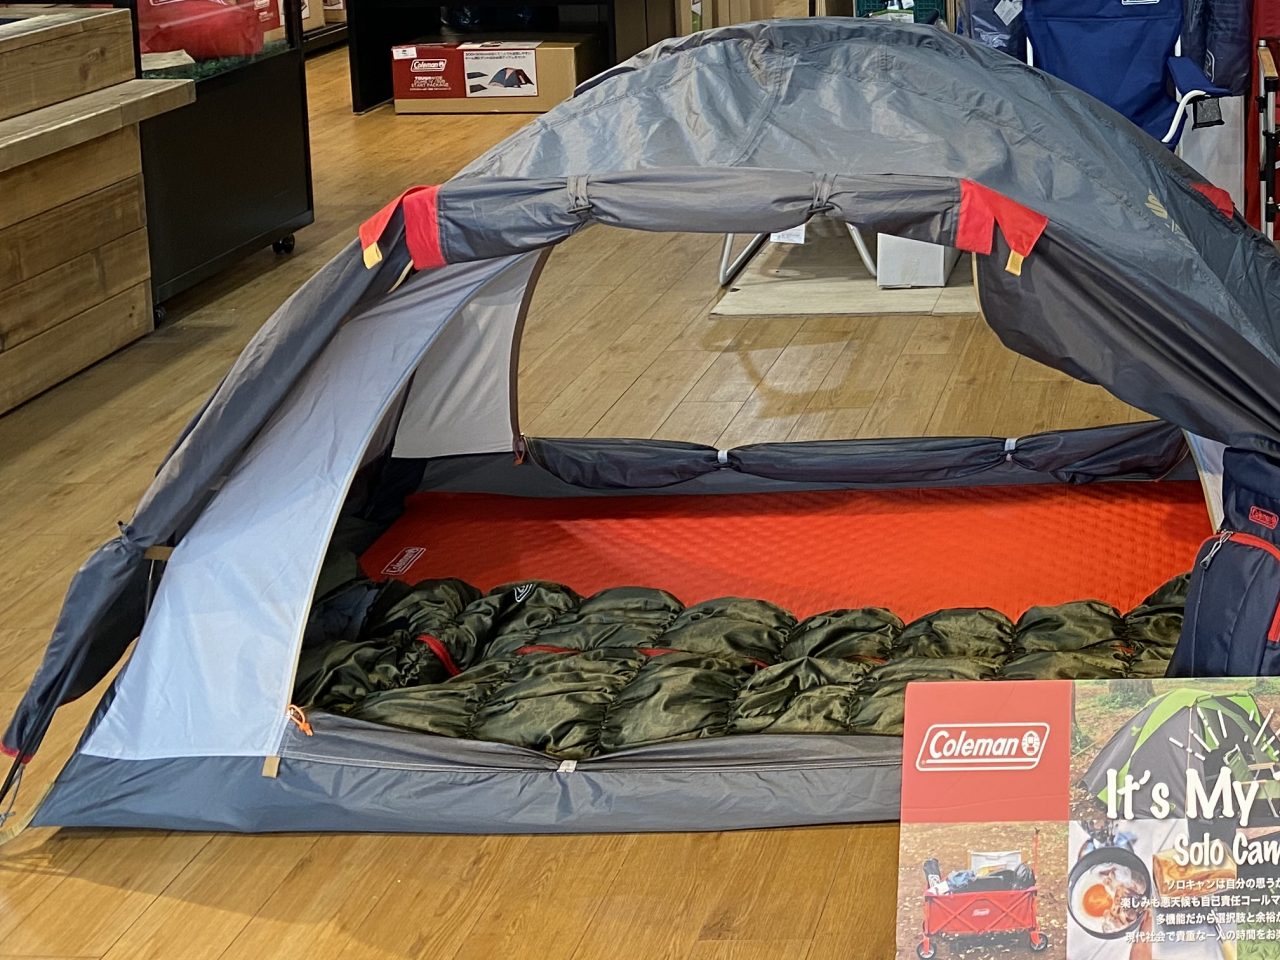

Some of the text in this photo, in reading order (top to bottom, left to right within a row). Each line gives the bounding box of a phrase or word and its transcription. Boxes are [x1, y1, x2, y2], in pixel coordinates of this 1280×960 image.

[930, 730, 1019, 759] Coleman
[1106, 769, 1170, 820] It's
[1185, 766, 1260, 827] My
[1173, 832, 1225, 867] Solo
